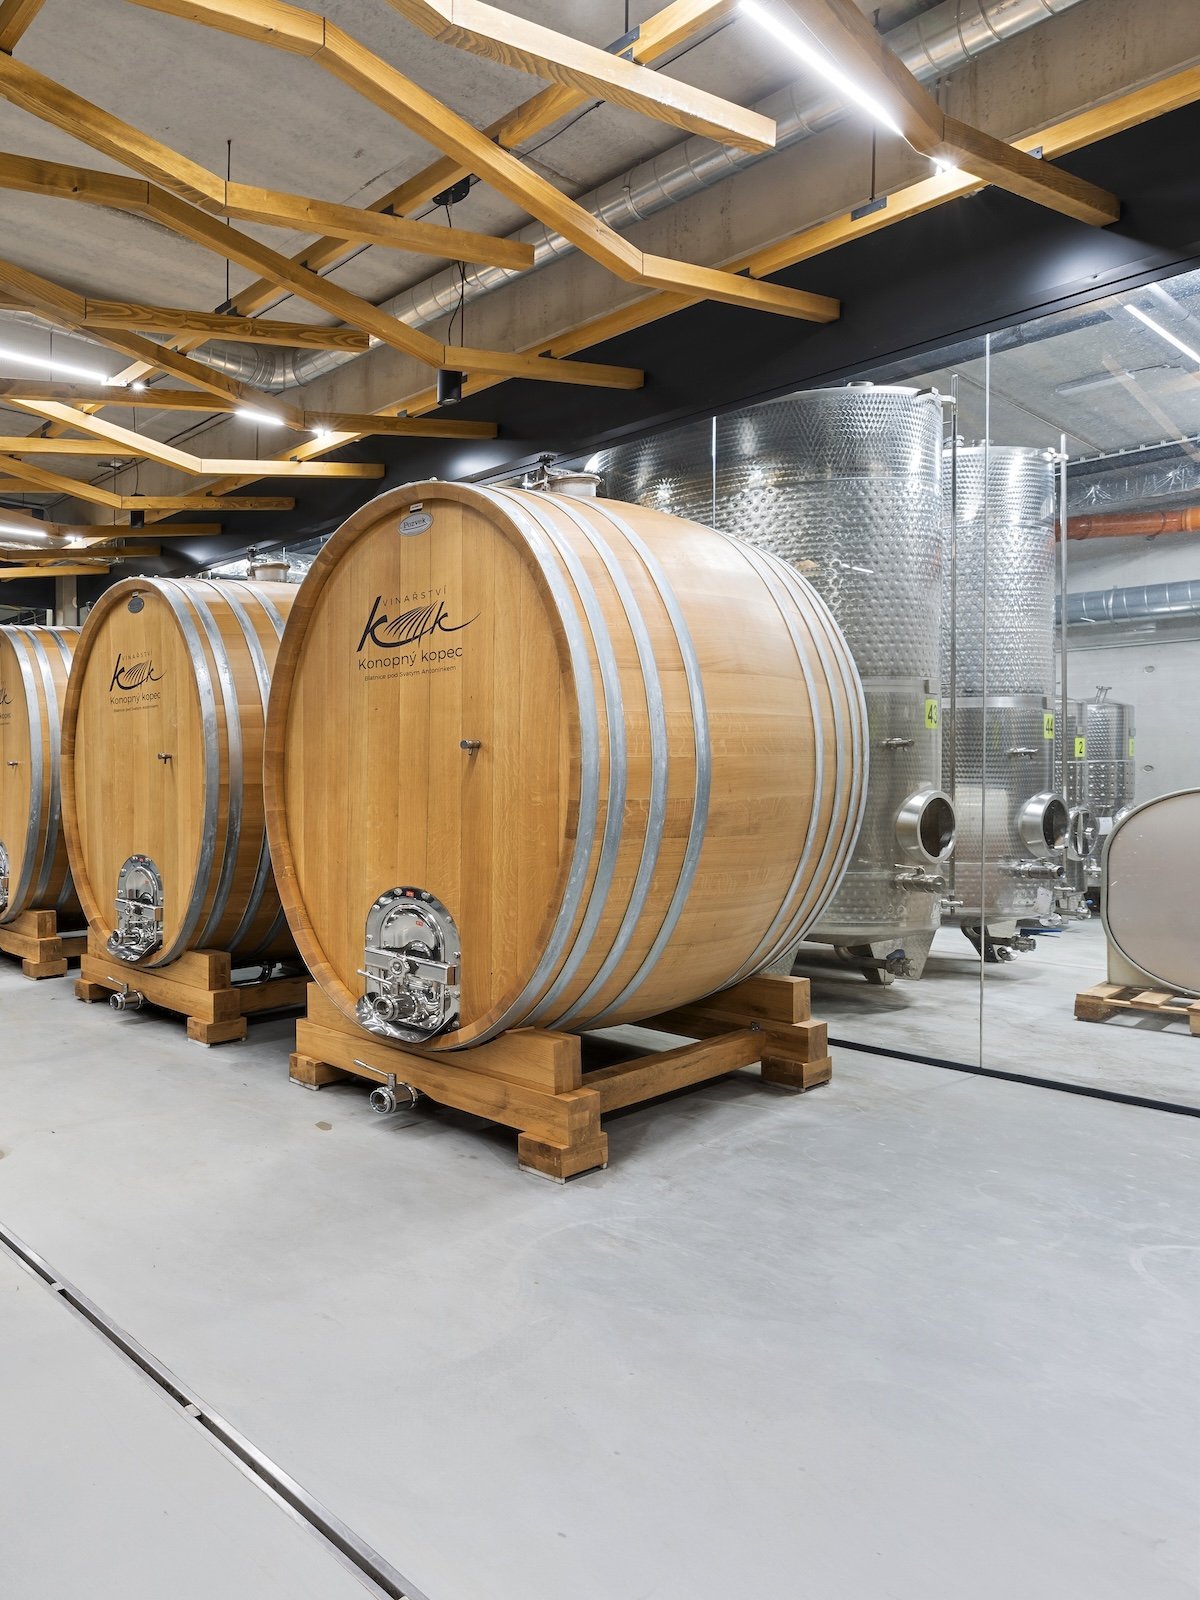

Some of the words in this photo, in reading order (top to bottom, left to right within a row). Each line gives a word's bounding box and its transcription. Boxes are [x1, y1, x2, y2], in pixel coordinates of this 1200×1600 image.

[382, 585, 447, 607] VINAŘSTVÍ
[358, 651, 417, 671] Konopný
[421, 647, 463, 664] kopec
[110, 692, 141, 705] Konopný
[141, 691, 161, 703] kopec
[927, 704, 938, 724] 43
[1078, 741, 1084, 754] 2
